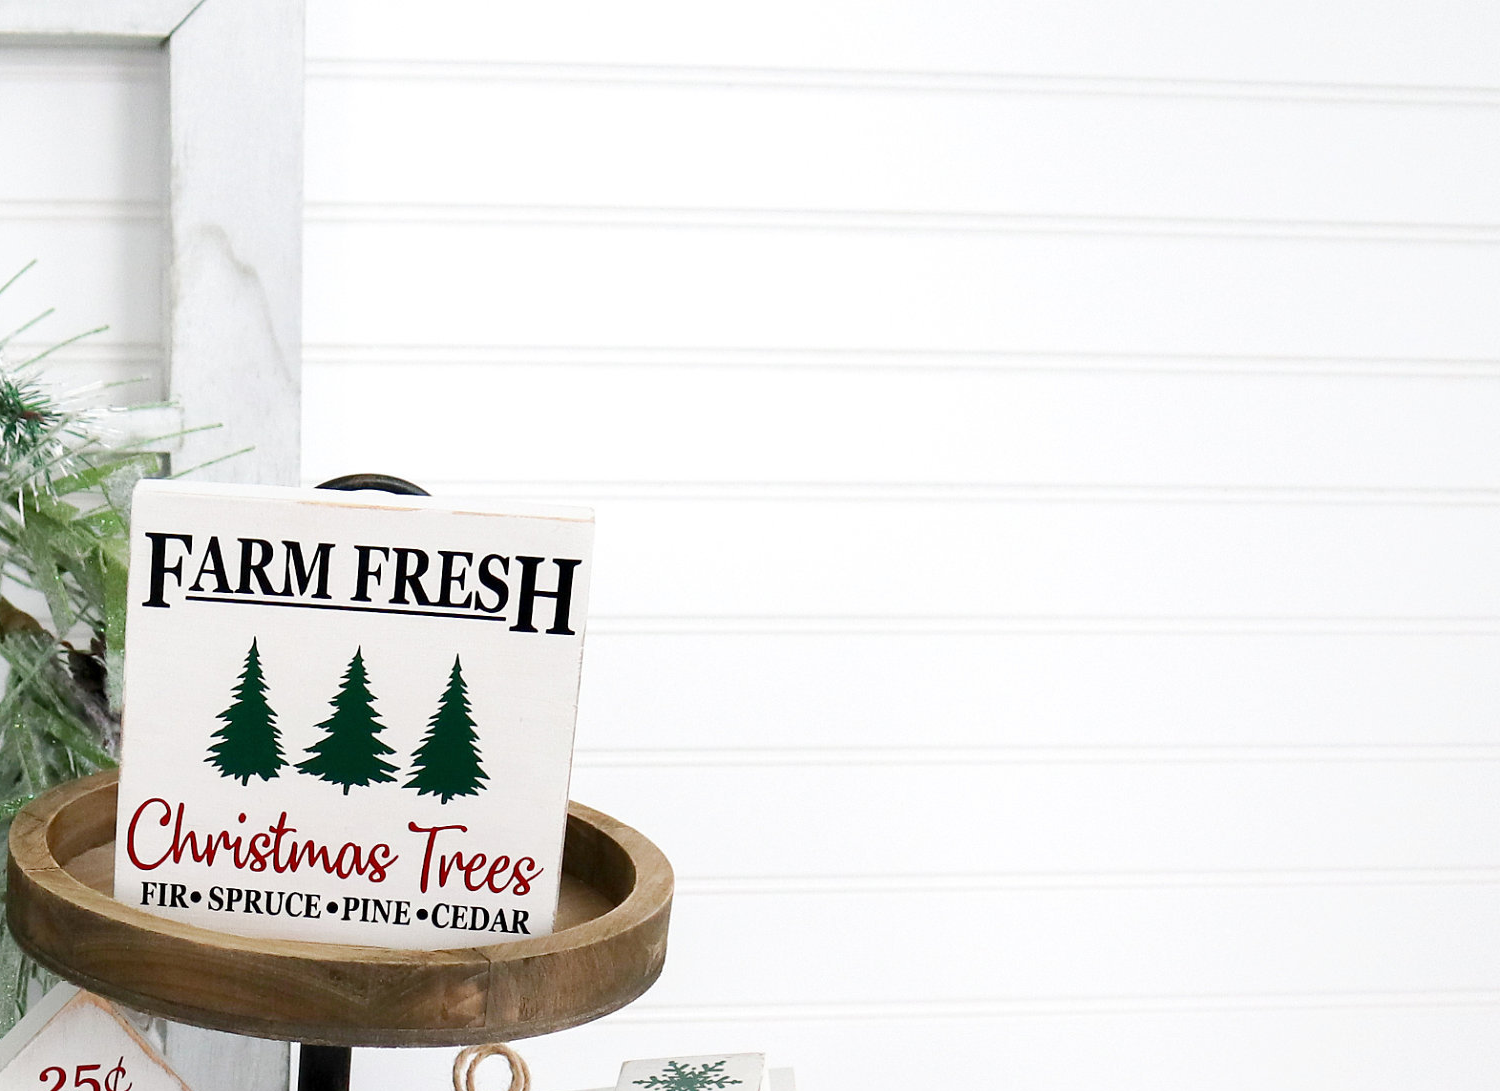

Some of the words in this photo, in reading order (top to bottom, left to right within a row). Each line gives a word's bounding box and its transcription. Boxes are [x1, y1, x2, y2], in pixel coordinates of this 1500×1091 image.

[142, 532, 336, 608] FARM
[350, 545, 582, 636] FRESH
[126, 797, 398, 884] Christmas
[408, 821, 544, 897] Trees
